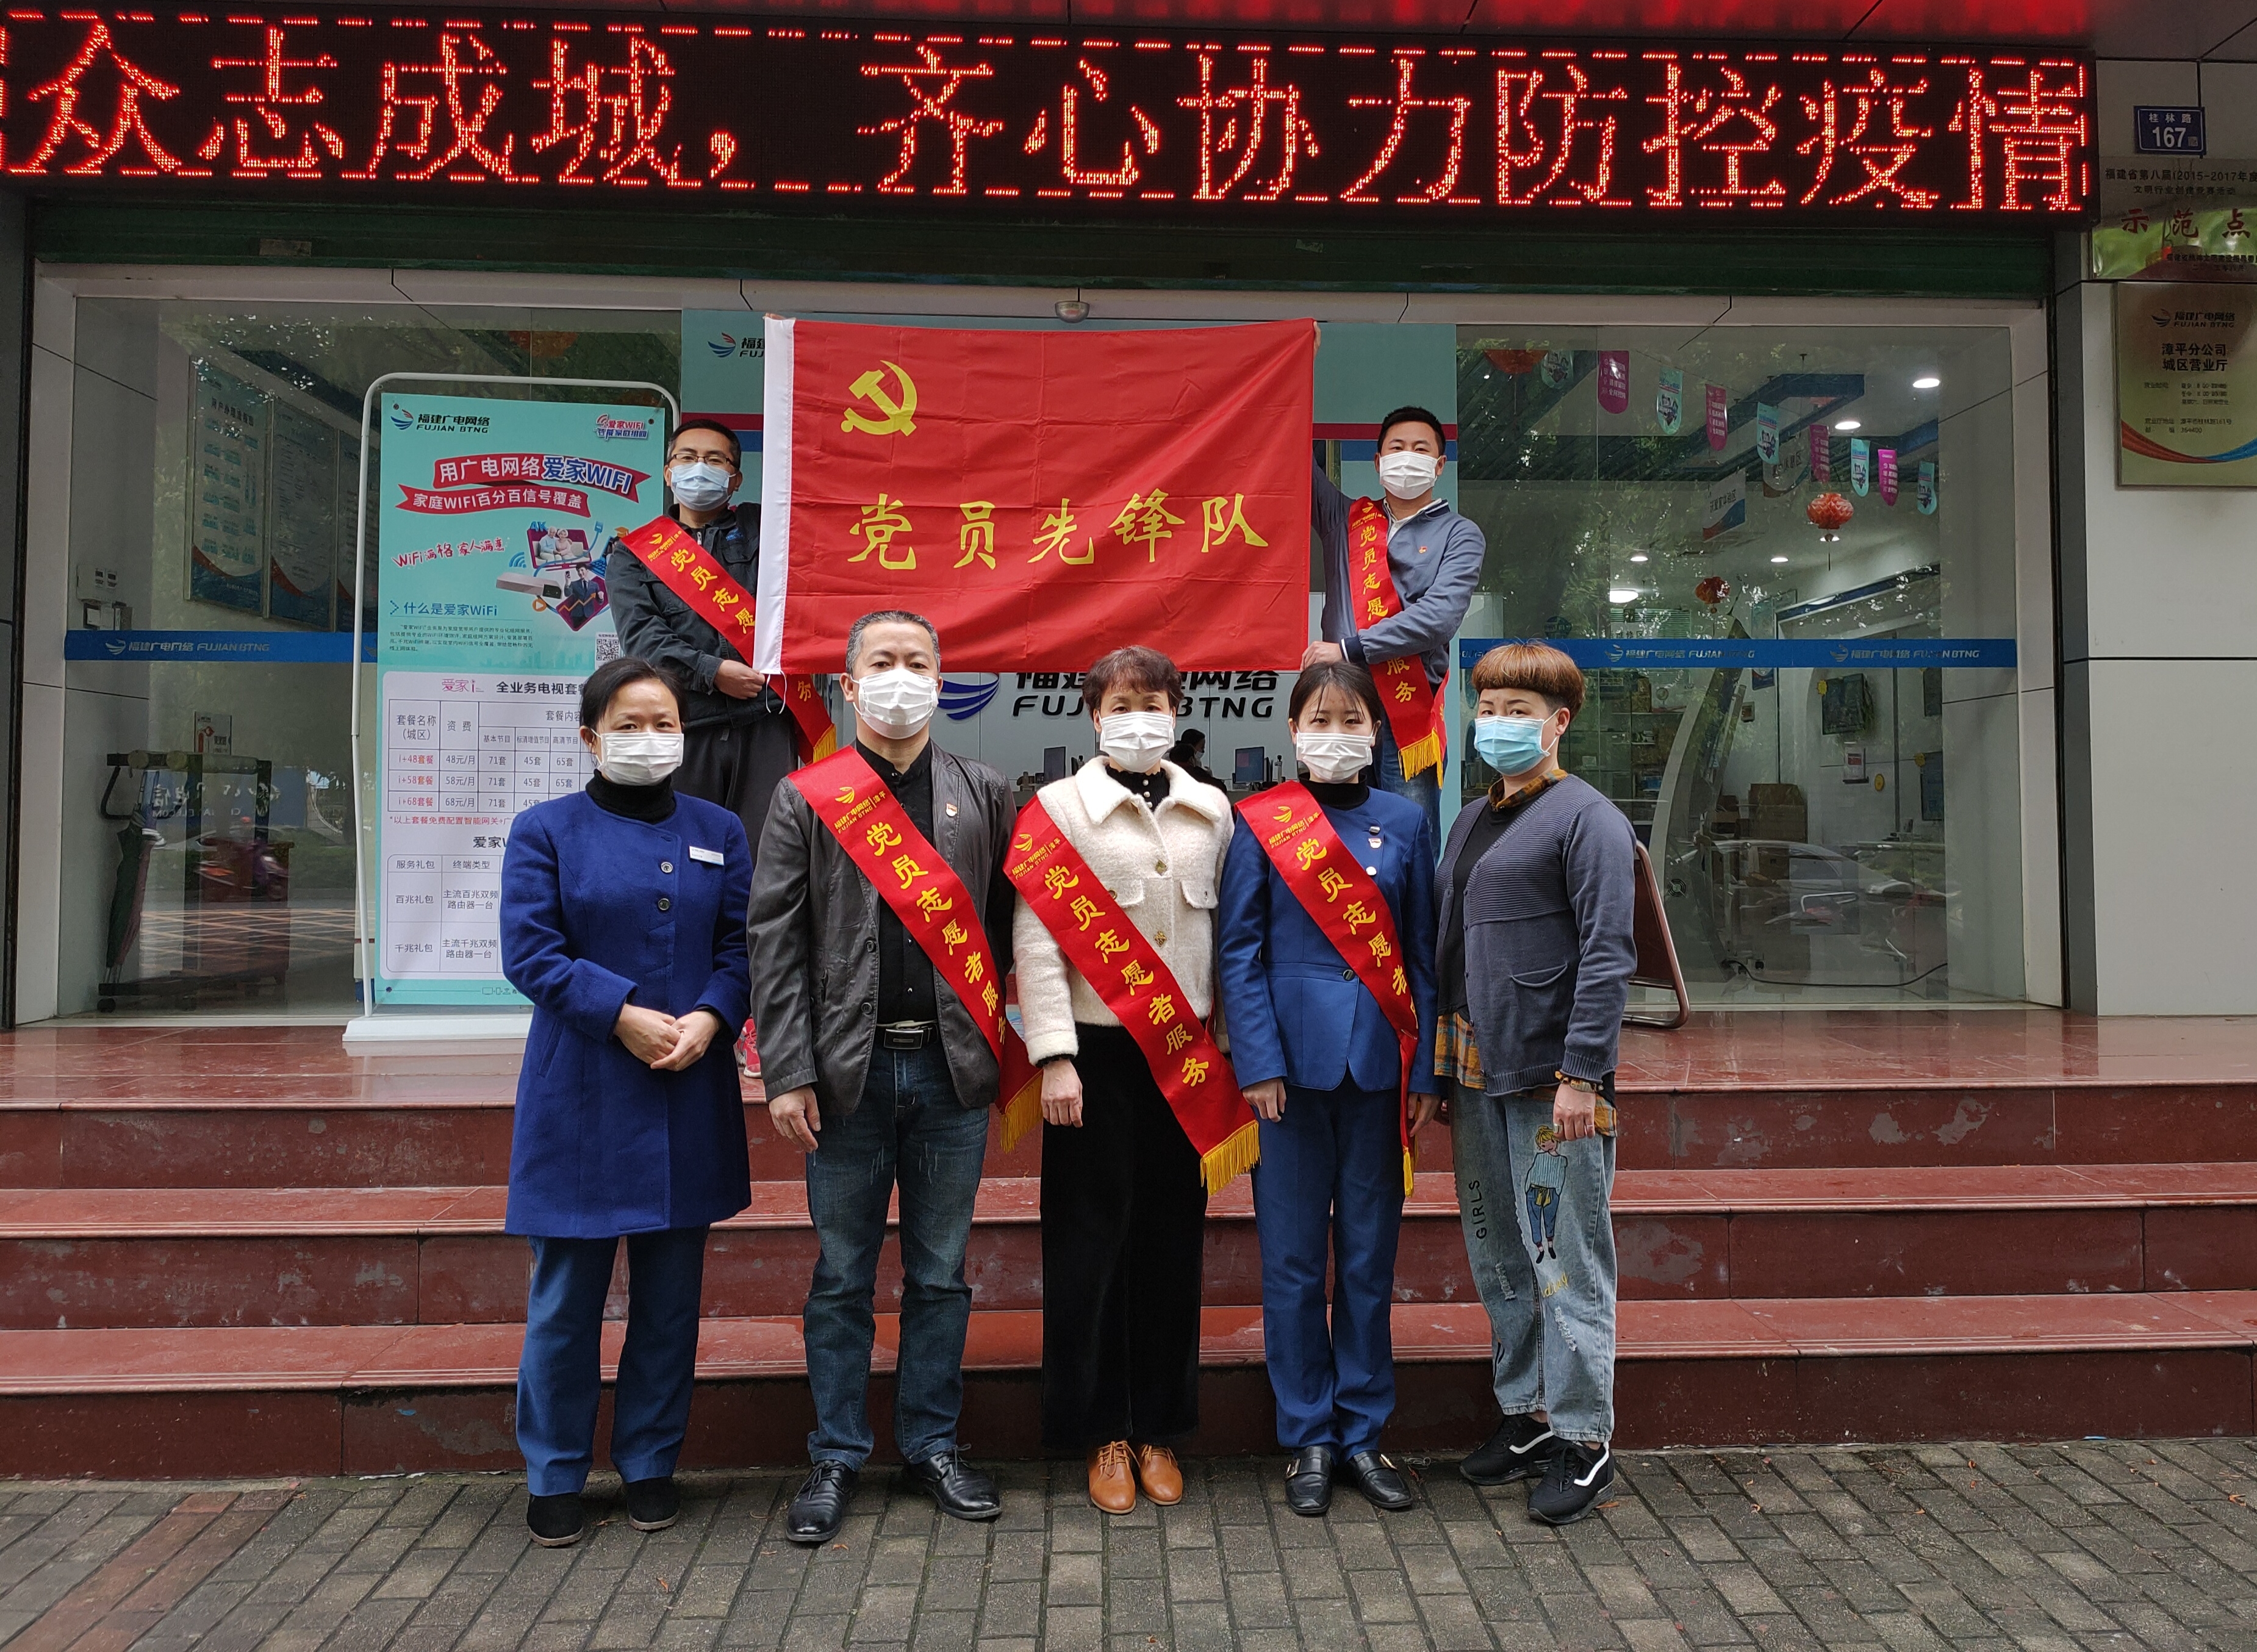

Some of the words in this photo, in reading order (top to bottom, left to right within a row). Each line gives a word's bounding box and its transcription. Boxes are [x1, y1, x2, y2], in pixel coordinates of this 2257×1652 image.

[27, 23, 2083, 211] 众志成城，齐心协力防控疫情
[2148, 113, 2192, 123] 桂林路
[2153, 126, 2186, 148] 167
[2121, 207, 2251, 239] 示范点
[2162, 343, 2226, 356] 漳平分公司
[2162, 359, 2228, 372] 城区营业厅
[418, 414, 490, 426] 福建广电网络
[439, 456, 633, 494] 用广电网络爱家WIFI
[412, 488, 582, 510] 家庭WIFI百分百信号覆盖
[847, 487, 1269, 570] 党员先锋队
[403, 602, 498, 616] 什么是爱家WiFi
[129, 642, 193, 652] 福建广电网络
[197, 642, 237, 652] FUJIAN
[239, 642, 270, 652] BTNG
[1851, 650, 1910, 659] 福建广电网络
[1952, 650, 1980, 659] BTNG
[396, 714, 436, 726] 套餐名称
[447, 720, 472, 732] 资费
[445, 755, 475, 765] 48元/月
[489, 756, 506, 766] 71套
[523, 756, 541, 766] 45套
[556, 758, 573, 767] 65套
[445, 777, 475, 786] 58元/月
[489, 777, 506, 787] 71套
[523, 778, 541, 787] 45套
[556, 779, 573, 788] 65套
[445, 797, 475, 807] 68元/月
[489, 798, 506, 808] 71套
[396, 860, 435, 869] 服务礼包
[453, 860, 490, 870] 终端类型
[395, 895, 434, 904] 百兆礼包
[443, 889, 498, 899] 主流百兆双频
[447, 901, 493, 910] 路由器一台
[395, 944, 432, 953] 千兆礼包
[442, 939, 497, 948] 主流千兆双频
[446, 950, 492, 958] 路由器一台
[1044, 864, 1210, 1088] 党员志愿者服务
[1469, 1179, 1487, 1240] GIRLS
